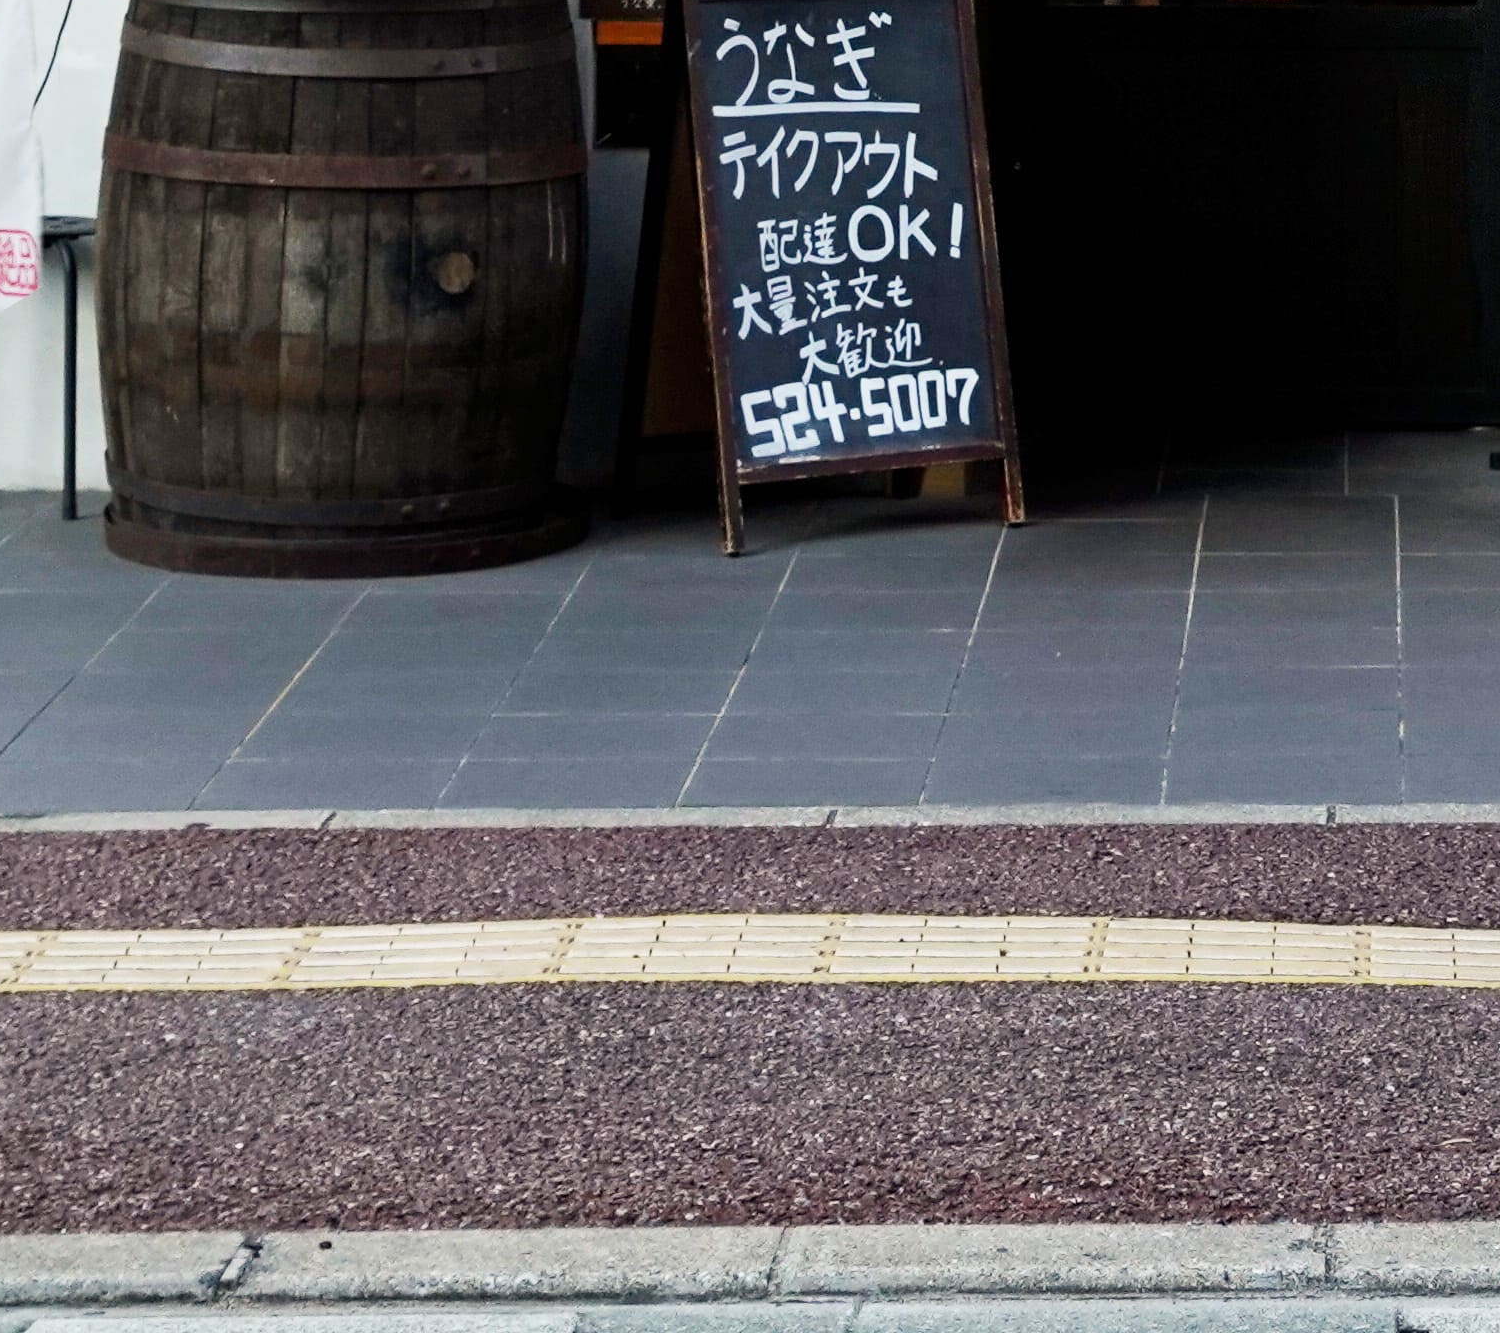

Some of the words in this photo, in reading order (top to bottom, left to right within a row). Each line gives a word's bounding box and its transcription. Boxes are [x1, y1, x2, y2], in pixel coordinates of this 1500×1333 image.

[715, 10, 893, 107] うなぎ
[719, 125, 938, 200] テイクアウト
[732, 266, 913, 340] 大量注文も
[800, 317, 933, 385] 大歓迎
